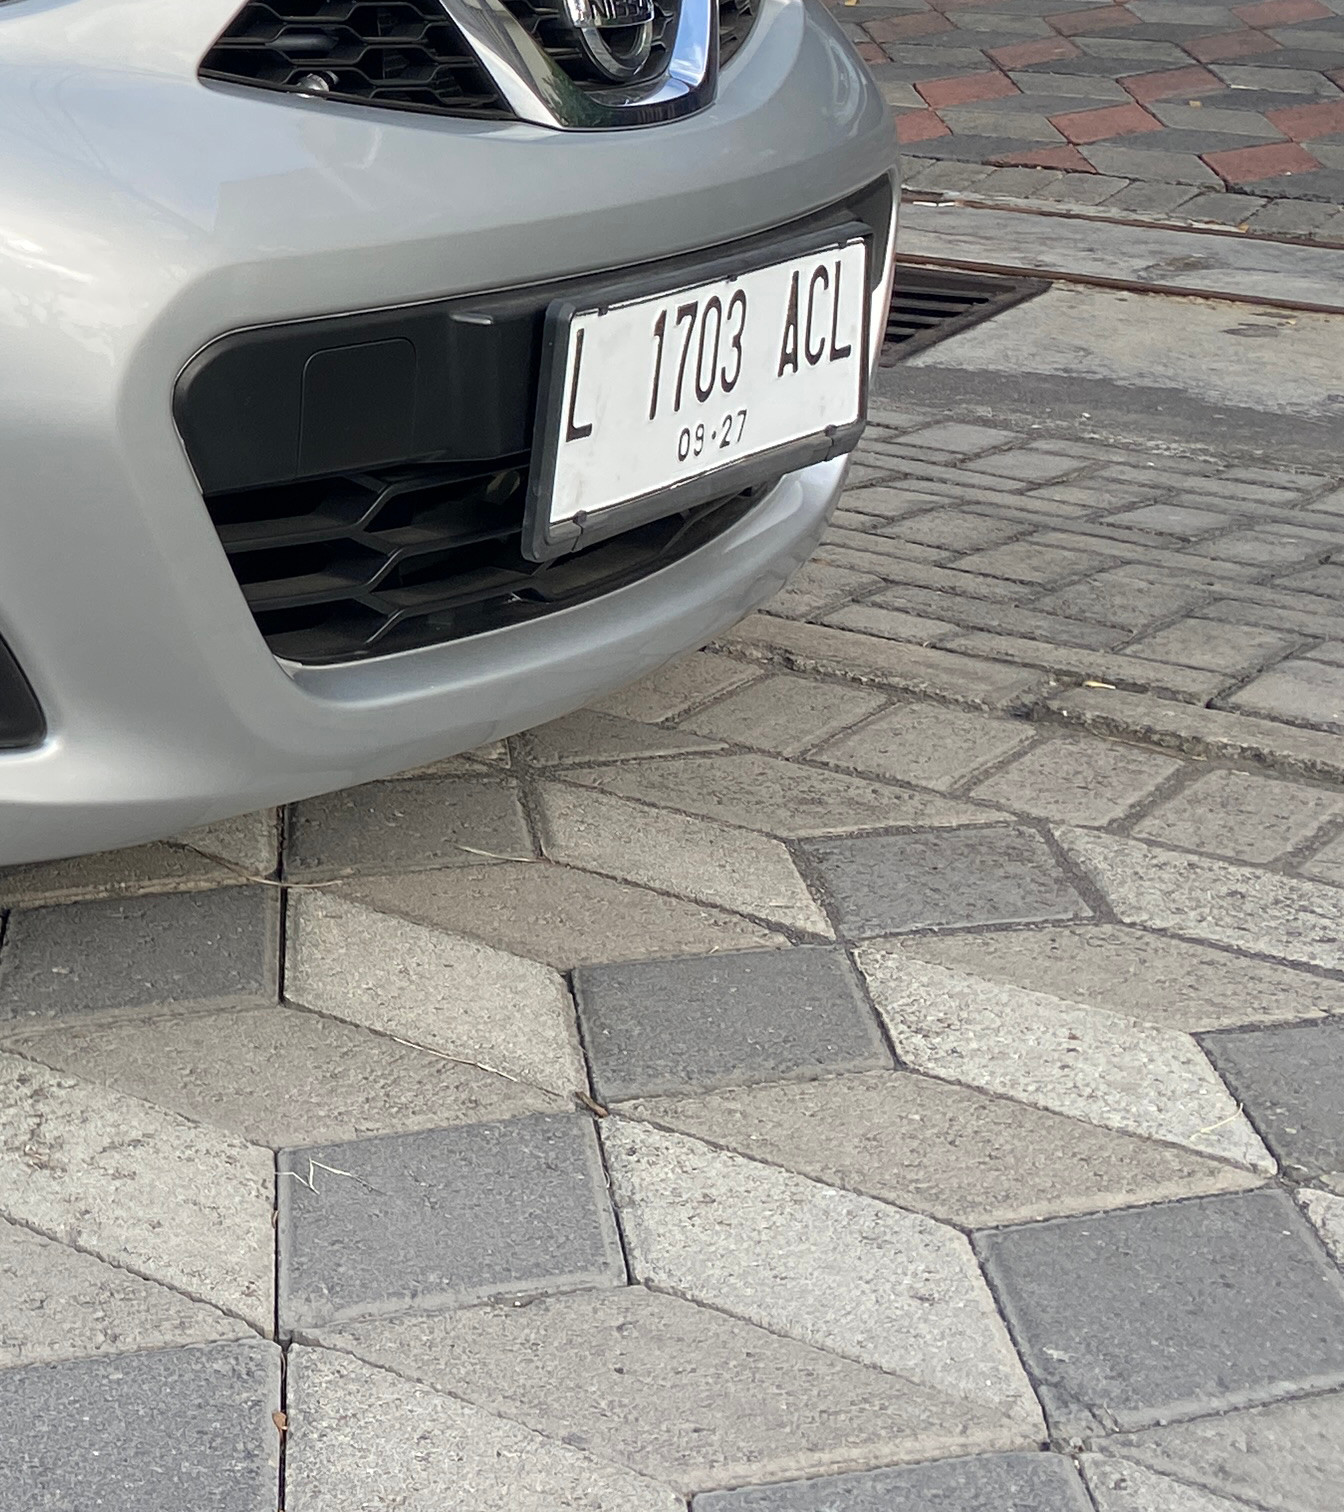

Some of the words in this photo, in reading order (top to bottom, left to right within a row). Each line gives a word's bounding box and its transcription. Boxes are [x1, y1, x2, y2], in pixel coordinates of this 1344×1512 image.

[565, 327, 593, 443] L
[648, 288, 747, 421] 1703
[777, 260, 852, 378] ACL
